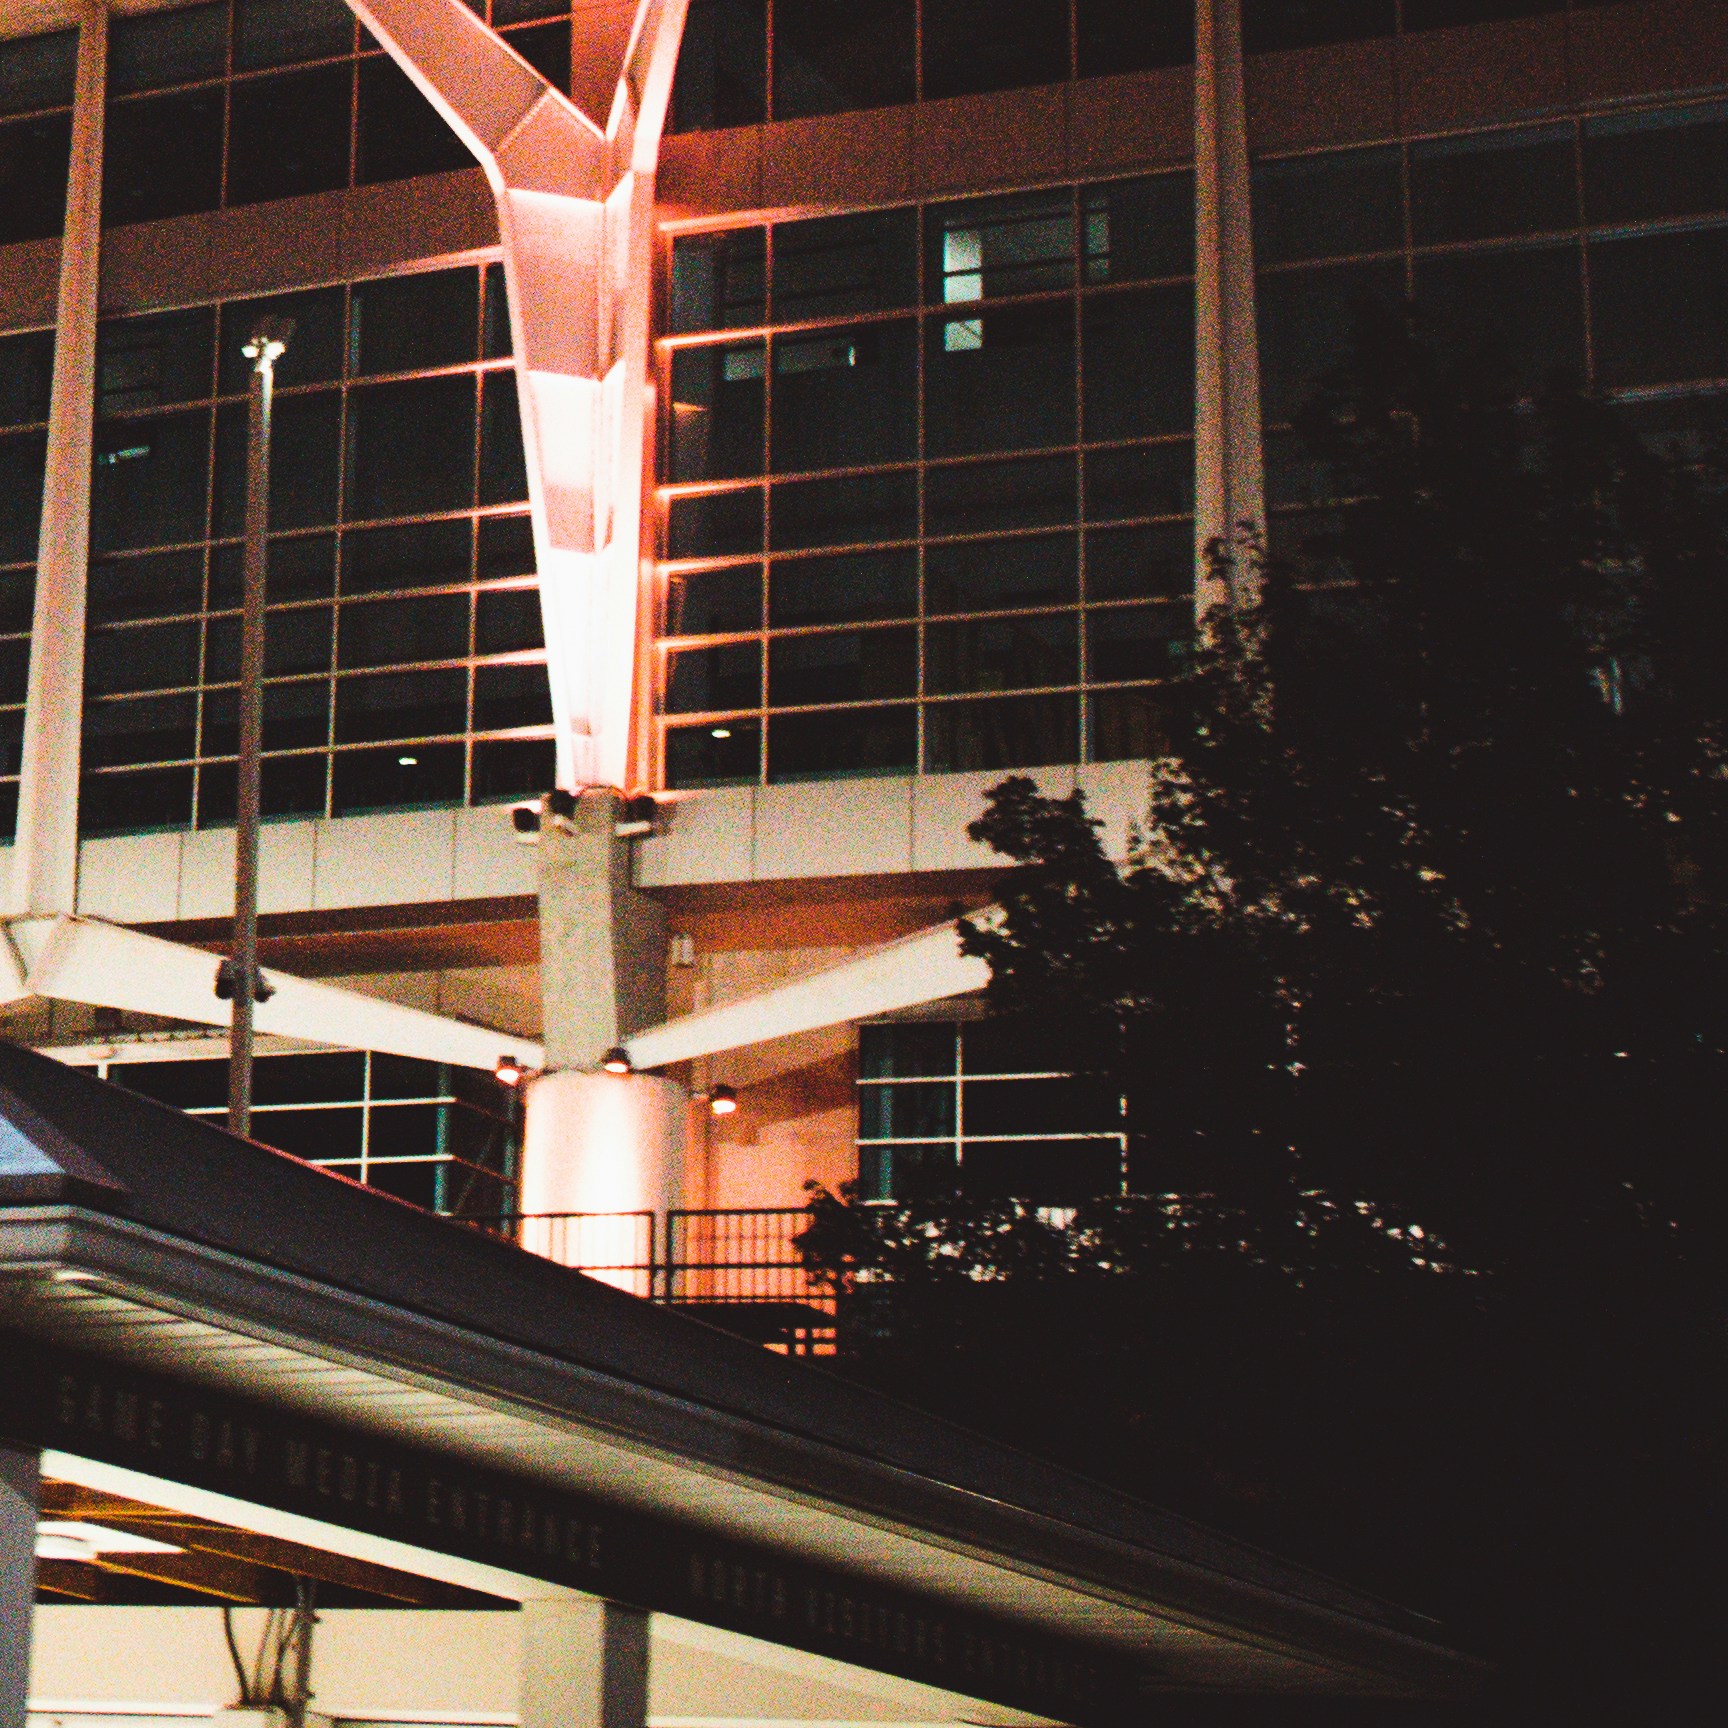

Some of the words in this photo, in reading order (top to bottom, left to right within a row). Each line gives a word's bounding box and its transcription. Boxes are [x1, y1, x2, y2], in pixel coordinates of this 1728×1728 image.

[56, 1375, 167, 1447] GAME
[189, 1411, 260, 1474] DAY
[285, 1438, 404, 1515] MEDIA
[425, 1478, 604, 1570] ENTRANCE
[688, 1552, 788, 1618] NORTH
